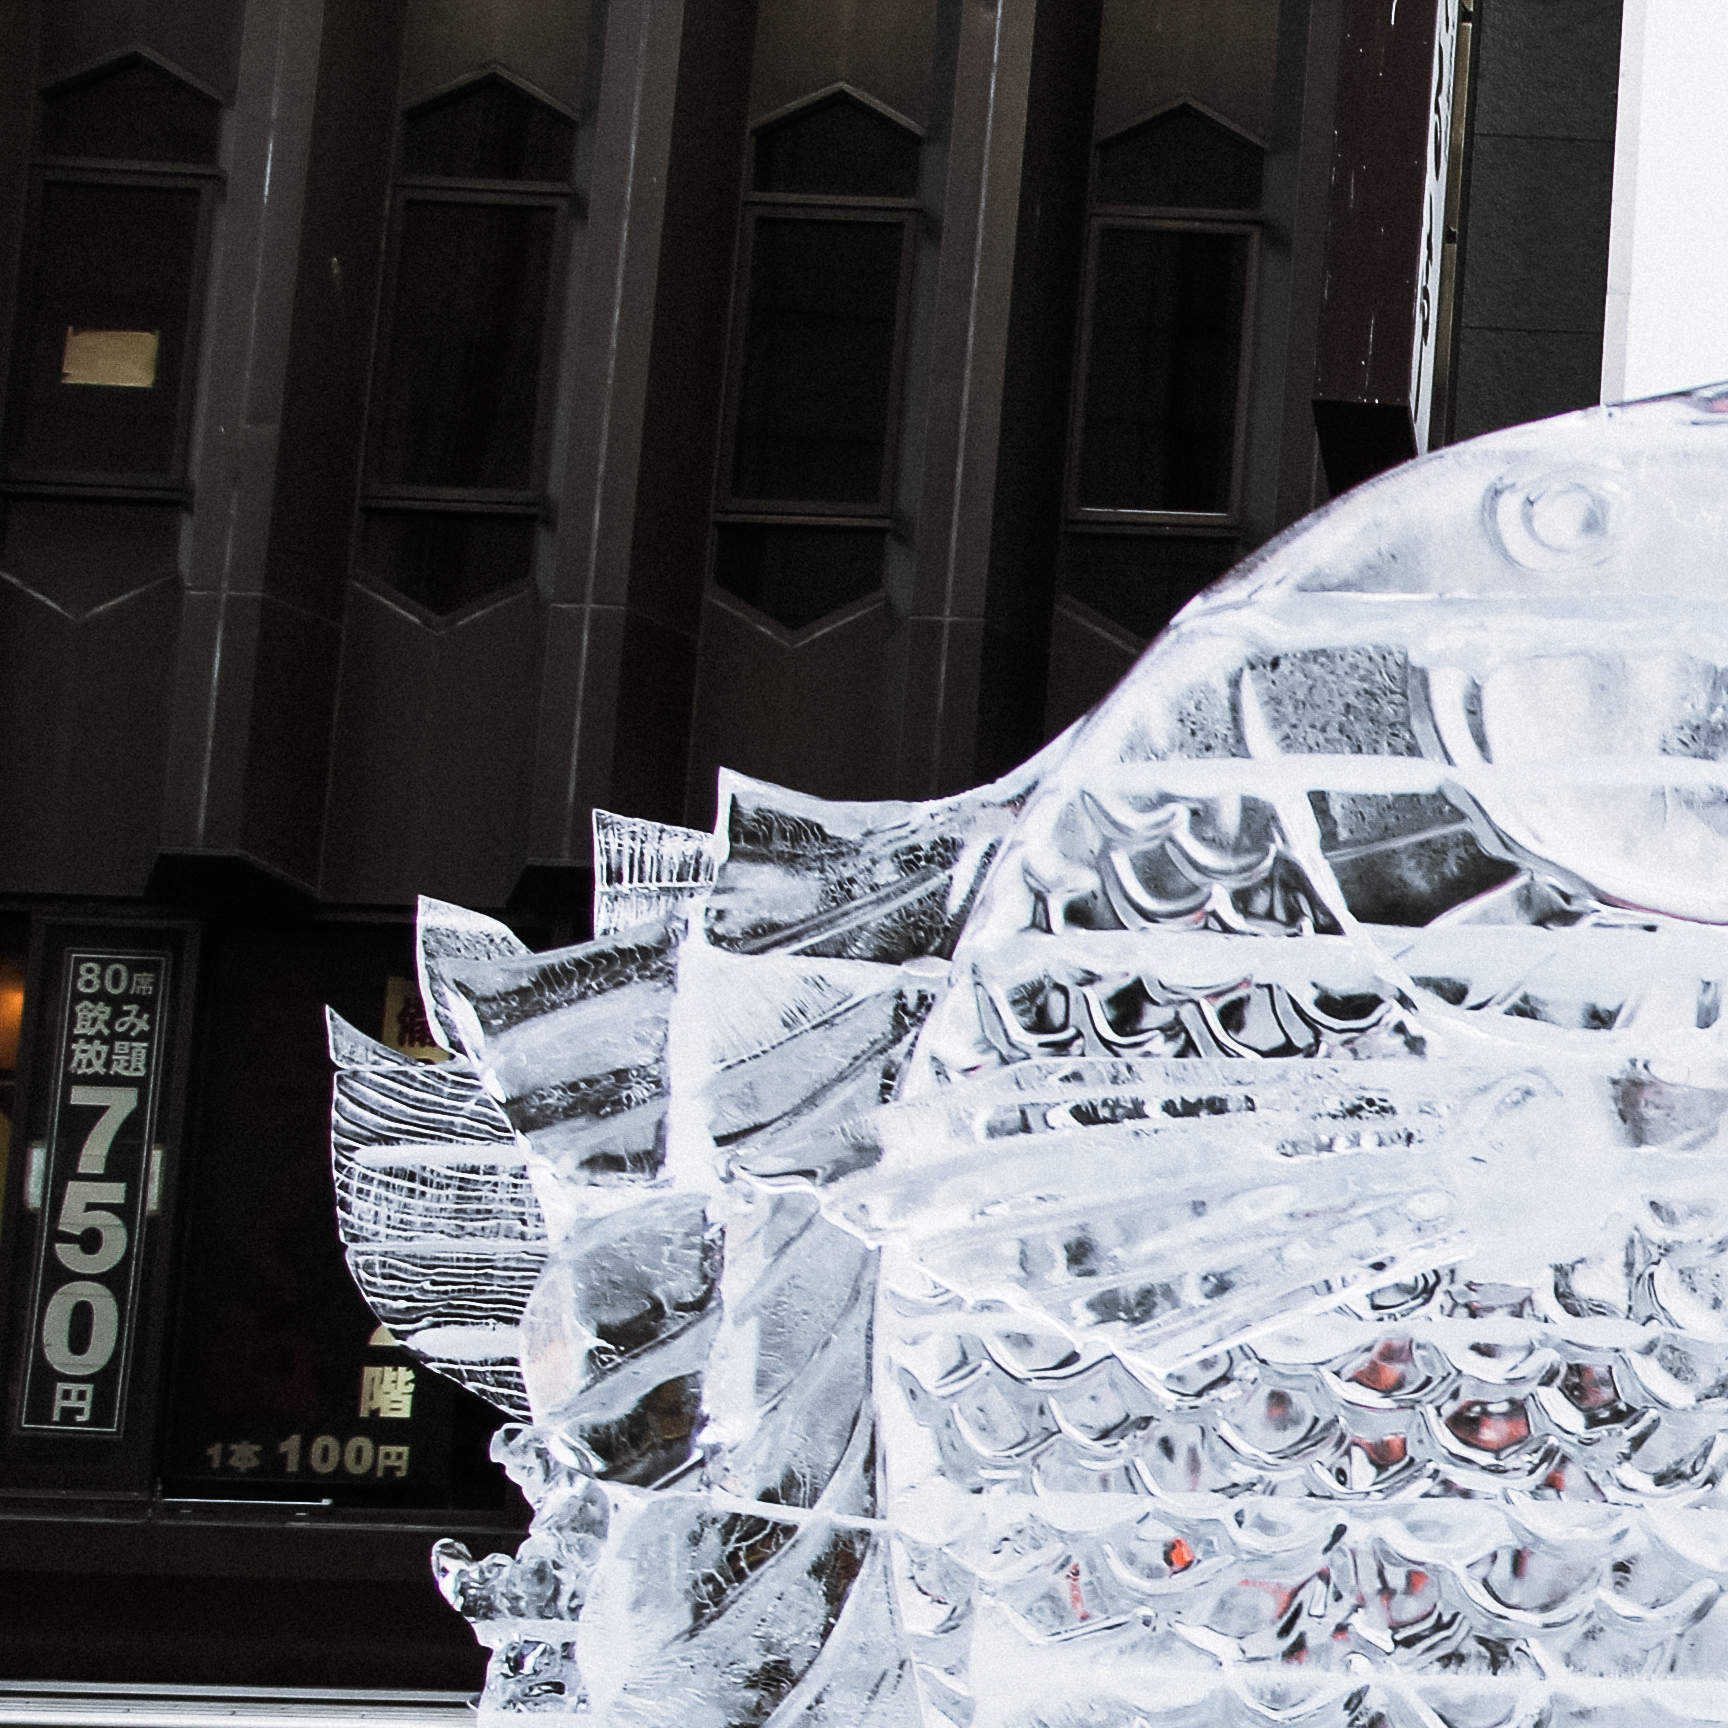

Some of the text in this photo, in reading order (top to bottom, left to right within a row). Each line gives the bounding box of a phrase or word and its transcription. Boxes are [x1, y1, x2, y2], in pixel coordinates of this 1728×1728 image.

[76, 963, 155, 995] 80席
[73, 1001, 150, 1036] 飲み
[69, 1039, 149, 1077] 放題
[43, 1086, 138, 1421] 750円
